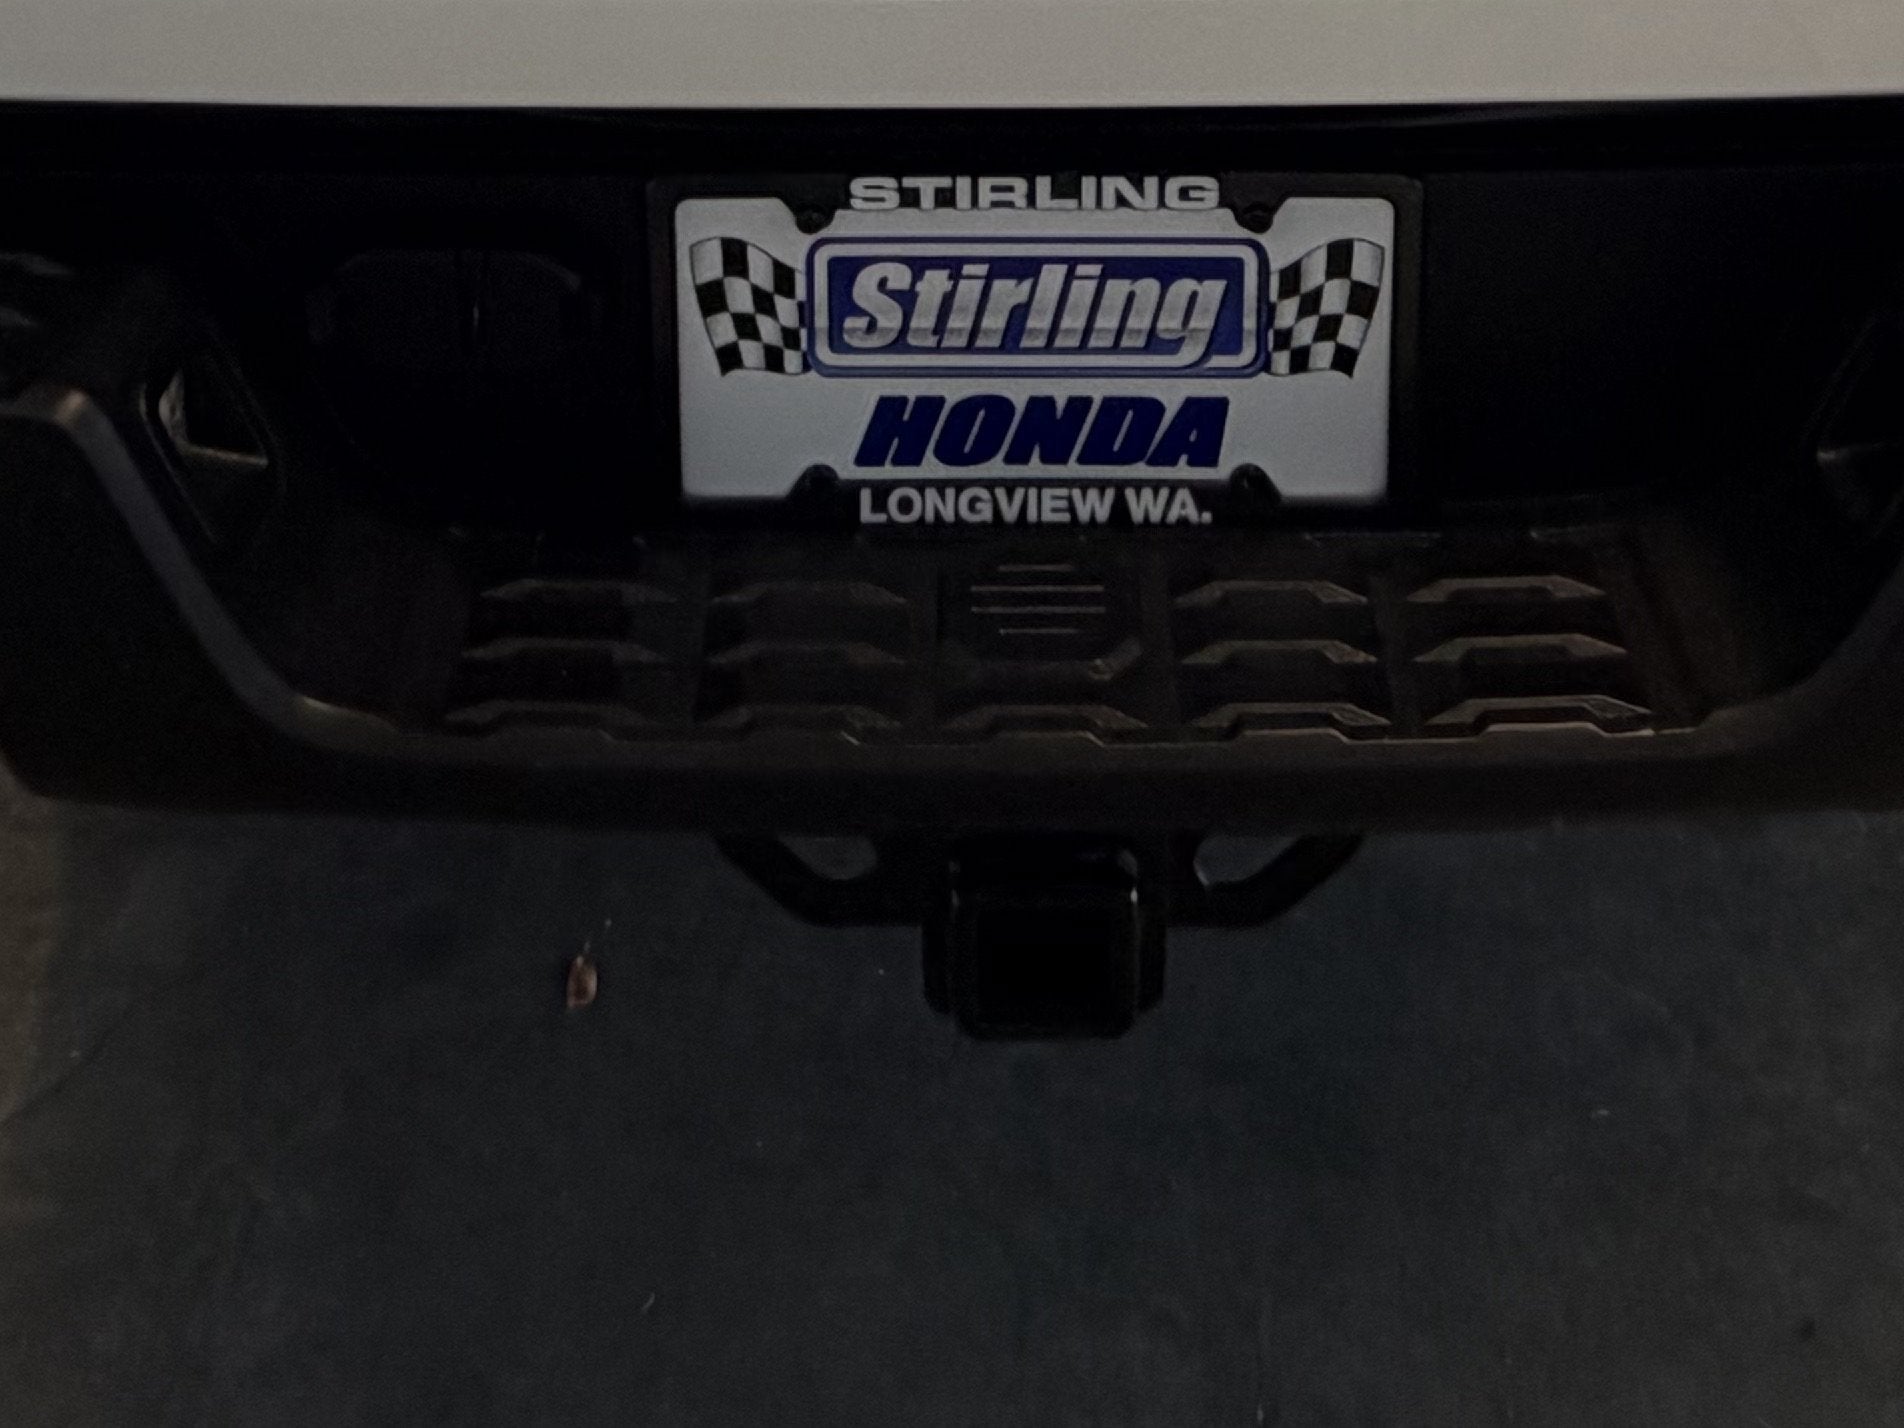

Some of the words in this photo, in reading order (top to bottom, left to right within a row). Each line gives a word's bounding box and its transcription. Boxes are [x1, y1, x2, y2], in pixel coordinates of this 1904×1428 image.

[849, 175, 1221, 211] STIRLING
[842, 261, 1227, 368] Stirling
[853, 394, 1231, 468] HONDA
[859, 486, 1119, 524] LONGVIEW
[1124, 486, 1213, 524] WA.
